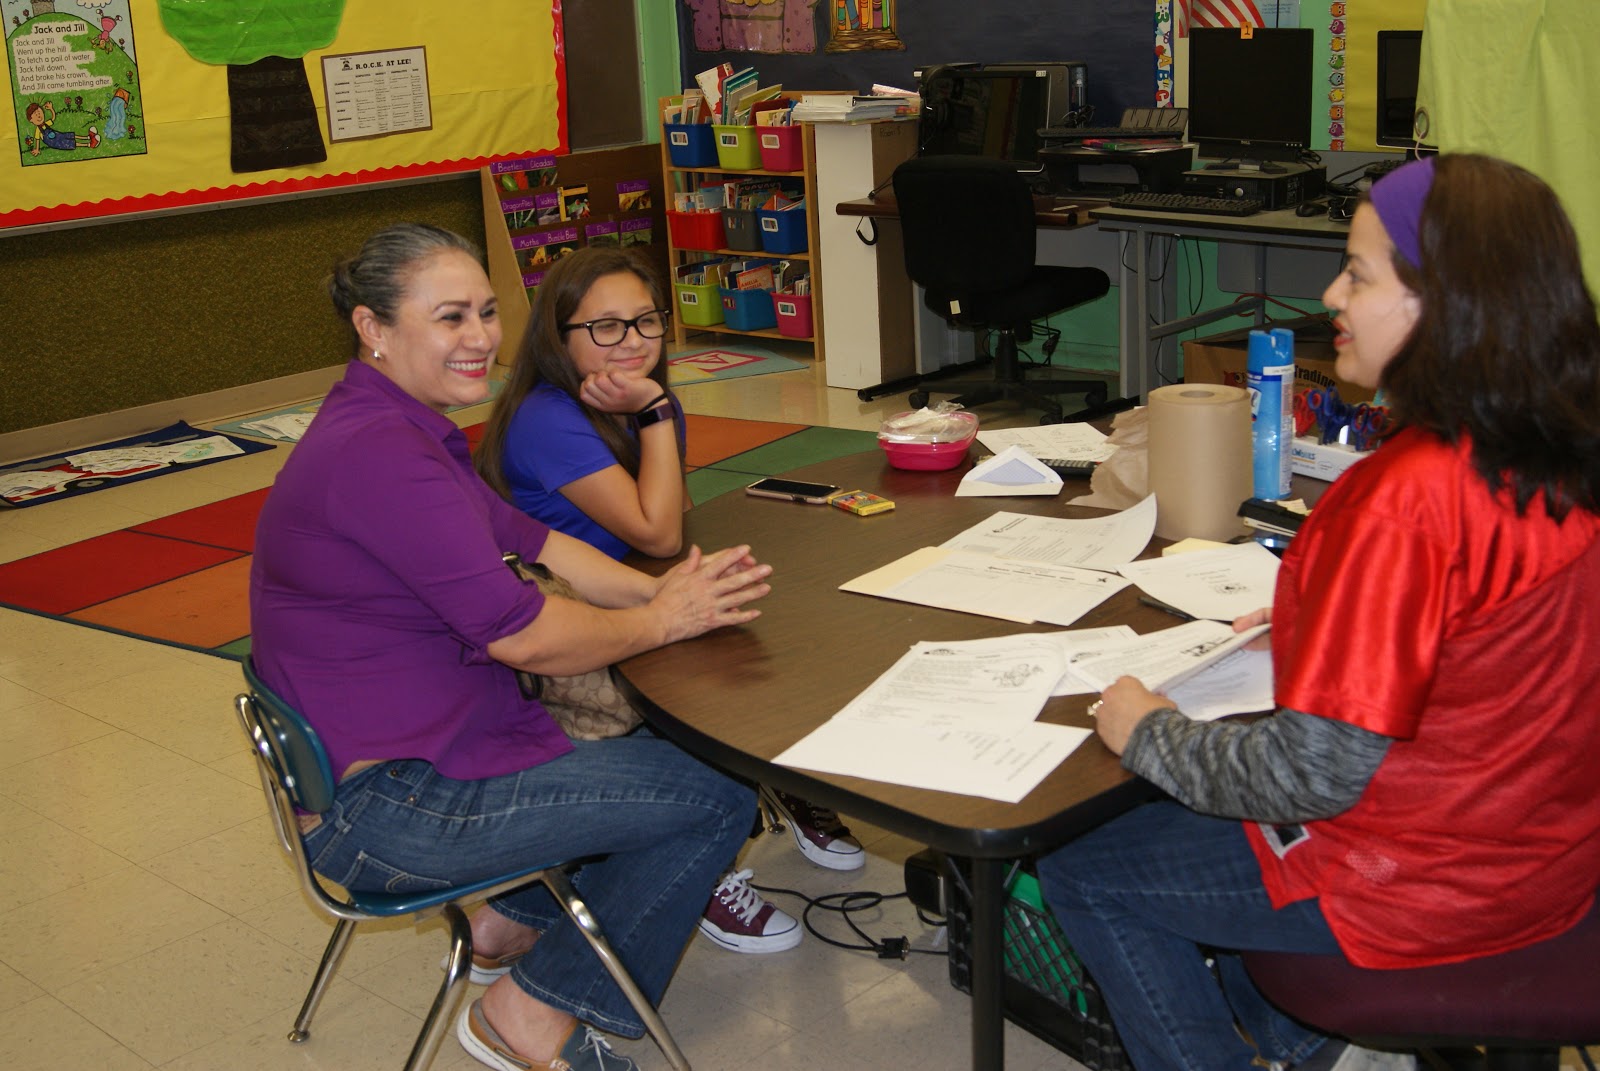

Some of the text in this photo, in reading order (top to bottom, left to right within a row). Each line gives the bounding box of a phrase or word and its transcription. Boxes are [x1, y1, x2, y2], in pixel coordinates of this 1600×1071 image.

[34, 24, 86, 34] Jack and Jill
[15, 37, 55, 46] Jack and Jill
[17, 47, 34, 56] Went
[27, 55, 43, 64] fetch
[50, 54, 63, 63] pail
[19, 65, 34, 74] Jack
[35, 64, 45, 72] fell
[20, 74, 34, 82] And
[35, 73, 55, 81] broke
[55, 71, 66, 79] his
[22, 83, 35, 91] And
[37, 82, 46, 90] Jill
[46, 81, 65, 89] came
[66, 79, 94, 88] tumbling
[497, 162, 523, 172] Beetles
[529, 159, 554, 169] Cicadas
[502, 199, 534, 211] Dragonflies
[547, 229, 578, 243] Bumble Bees
[520, 238, 540, 247] Moths
